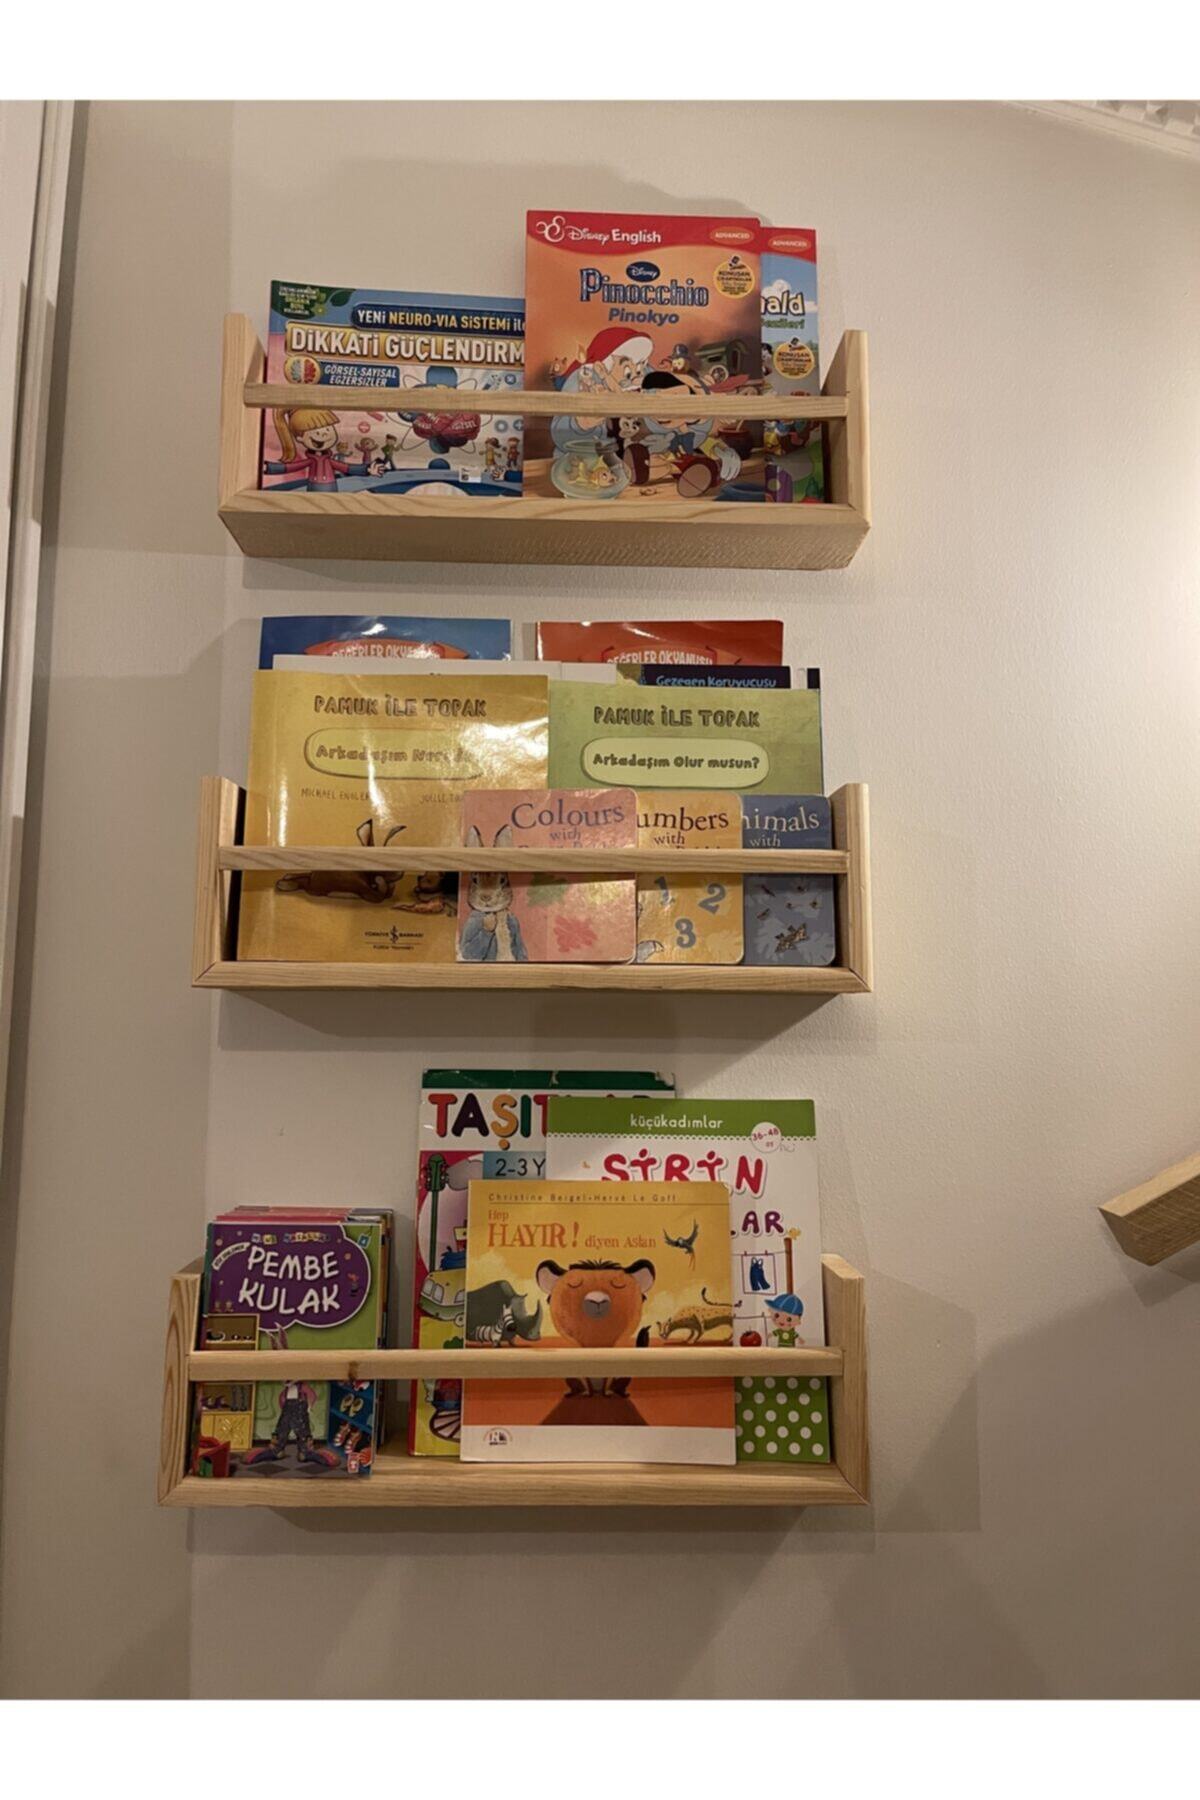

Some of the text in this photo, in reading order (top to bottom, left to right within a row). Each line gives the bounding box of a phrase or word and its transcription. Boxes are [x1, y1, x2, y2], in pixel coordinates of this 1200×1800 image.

[567, 225, 662, 245] Disney English
[715, 232, 750, 240] ADVANCED
[773, 240, 807, 248] ADVANCED
[580, 268, 709, 307] Pinocchio
[761, 290, 805, 316] nald
[388, 311, 458, 328] NEURO-VIA
[609, 307, 680, 326] Pinokyo
[656, 675, 777, 688] Gezegen Koruyucusu
[314, 695, 378, 715] PAMUK
[423, 698, 487, 717] TOPAK
[593, 706, 655, 726] PAMUK
[698, 709, 760, 728] TOPAK
[593, 752, 760, 770] Arkadaşım Olur musun?
[511, 799, 625, 830] Colours
[636, 807, 729, 832] umbers
[743, 806, 820, 833] nimals
[549, 827, 582, 841] with
[653, 831, 685, 846] with
[750, 834, 781, 848] with
[654, 876, 675, 907] 1
[698, 882, 727, 915] 2
[674, 917, 697, 948] 3
[428, 1092, 549, 1150] TAŞIT
[630, 1113, 723, 1131] küçükadımlar
[495, 1158, 547, 1176] 2-3 Y
[488, 1193, 543, 1201] Christine
[633, 1194, 646, 1202] Le
[488, 1209, 509, 1222] Hep
[731, 1210, 784, 1236] AR
[585, 1235, 619, 1250] diyen
[623, 1235, 656, 1248] Aslan
[248, 1245, 340, 1281] PEMBE
[238, 1278, 340, 1315] KULAK
